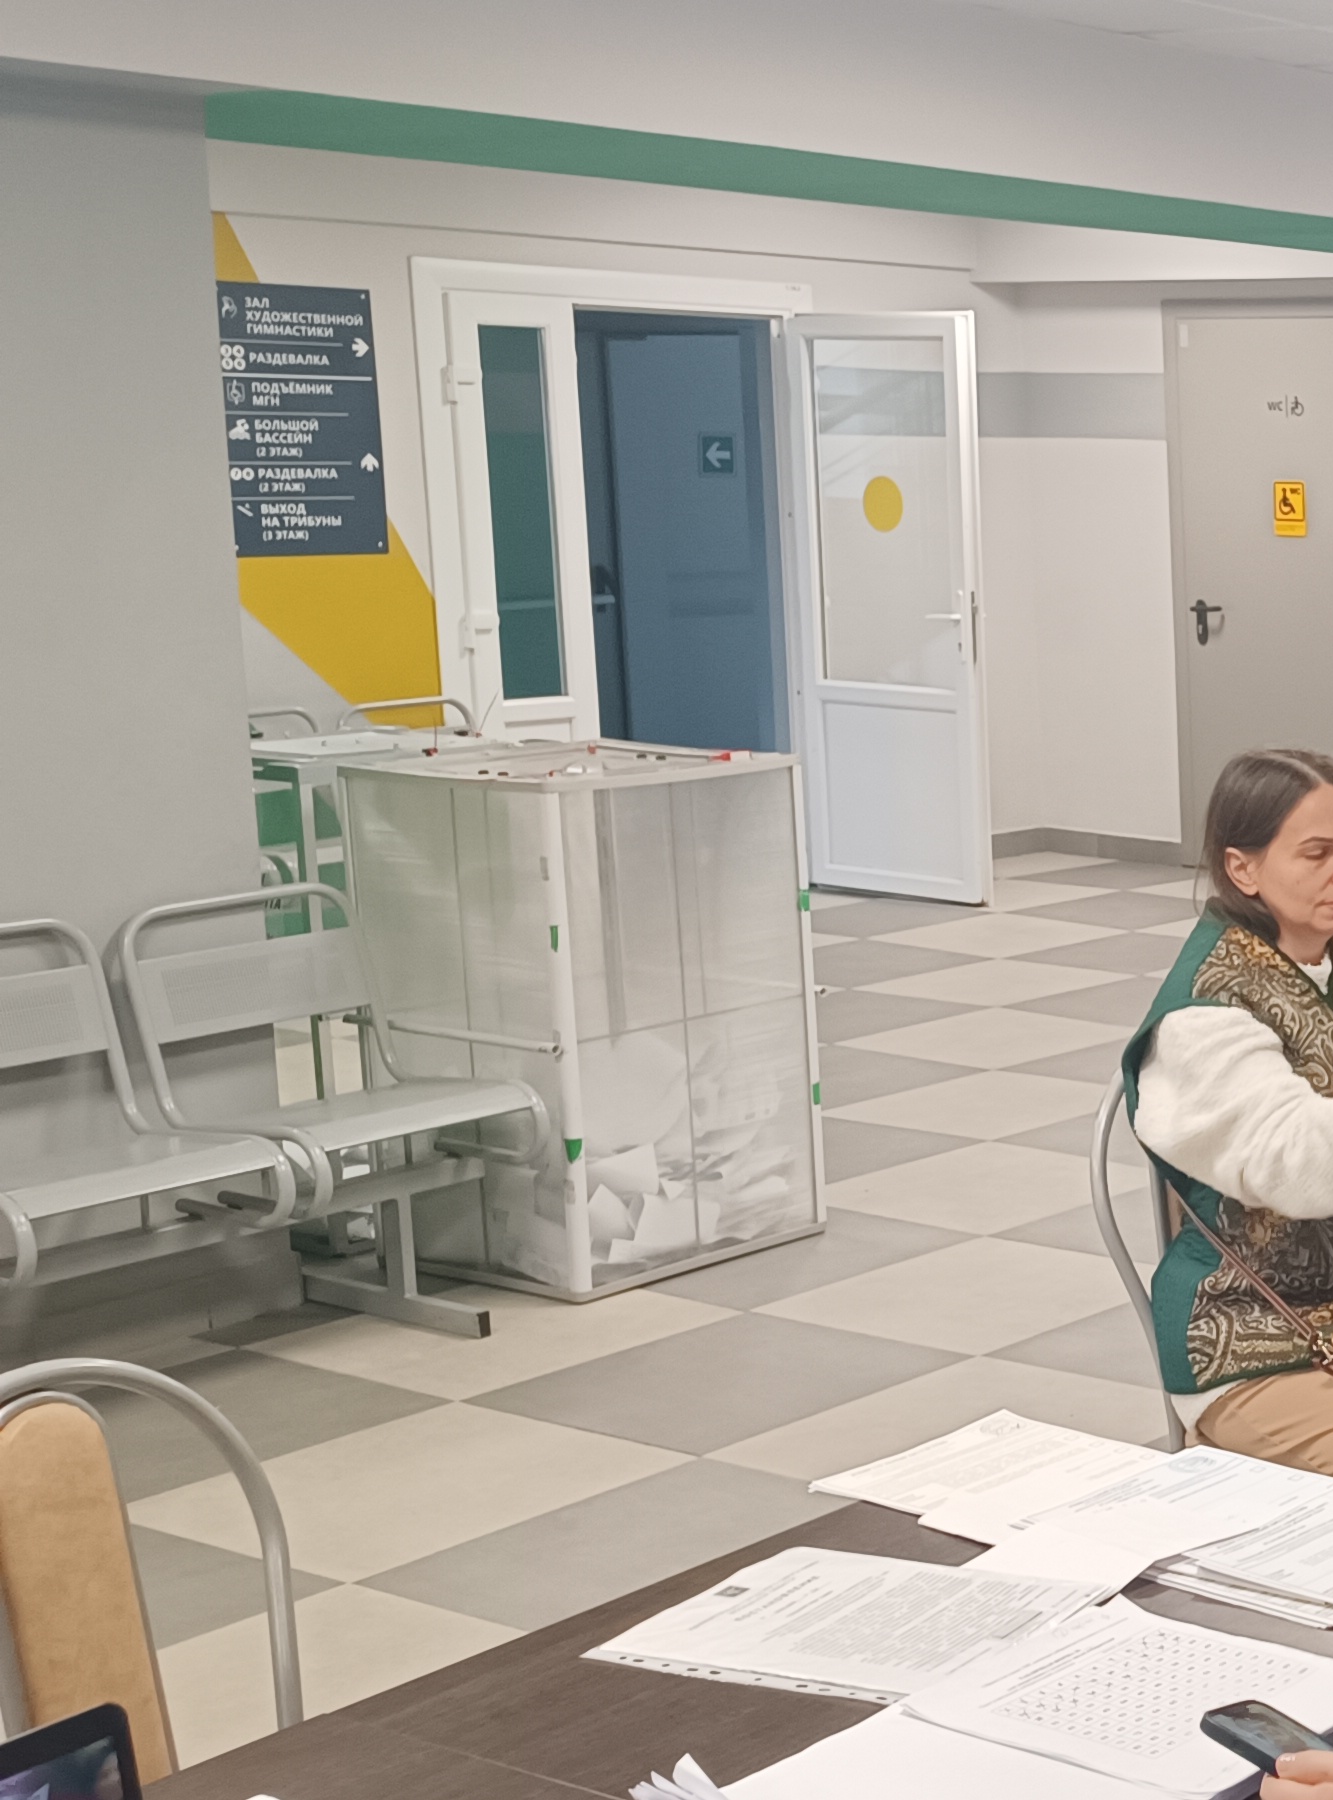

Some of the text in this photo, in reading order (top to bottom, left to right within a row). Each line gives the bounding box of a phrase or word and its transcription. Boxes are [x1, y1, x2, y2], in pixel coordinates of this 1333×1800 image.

[244, 296, 270, 309] ЗАЛ
[245, 310, 364, 327] ХУДОЖЕСТВЕННОЙ
[246, 323, 334, 338] ГИМНАСТИКИ
[249, 352, 330, 366] РАЗДЕВАЛКА
[252, 395, 280, 407] МГН
[1266, 400, 1283, 412] WC
[254, 418, 319, 431] БОЛЬШОЙ
[255, 431, 313, 444] БАССЕЙН
[268, 446, 303, 459] ЭТАЖ)
[258, 467, 338, 480] РАЗДЕВАЛКА
[271, 482, 306, 494] ЭТАЖ)
[260, 503, 307, 515] ВЫХОД
[261, 516, 342, 527] НА ТРИБУНЫ
[275, 530, 309, 541] ЭТАЖ)
